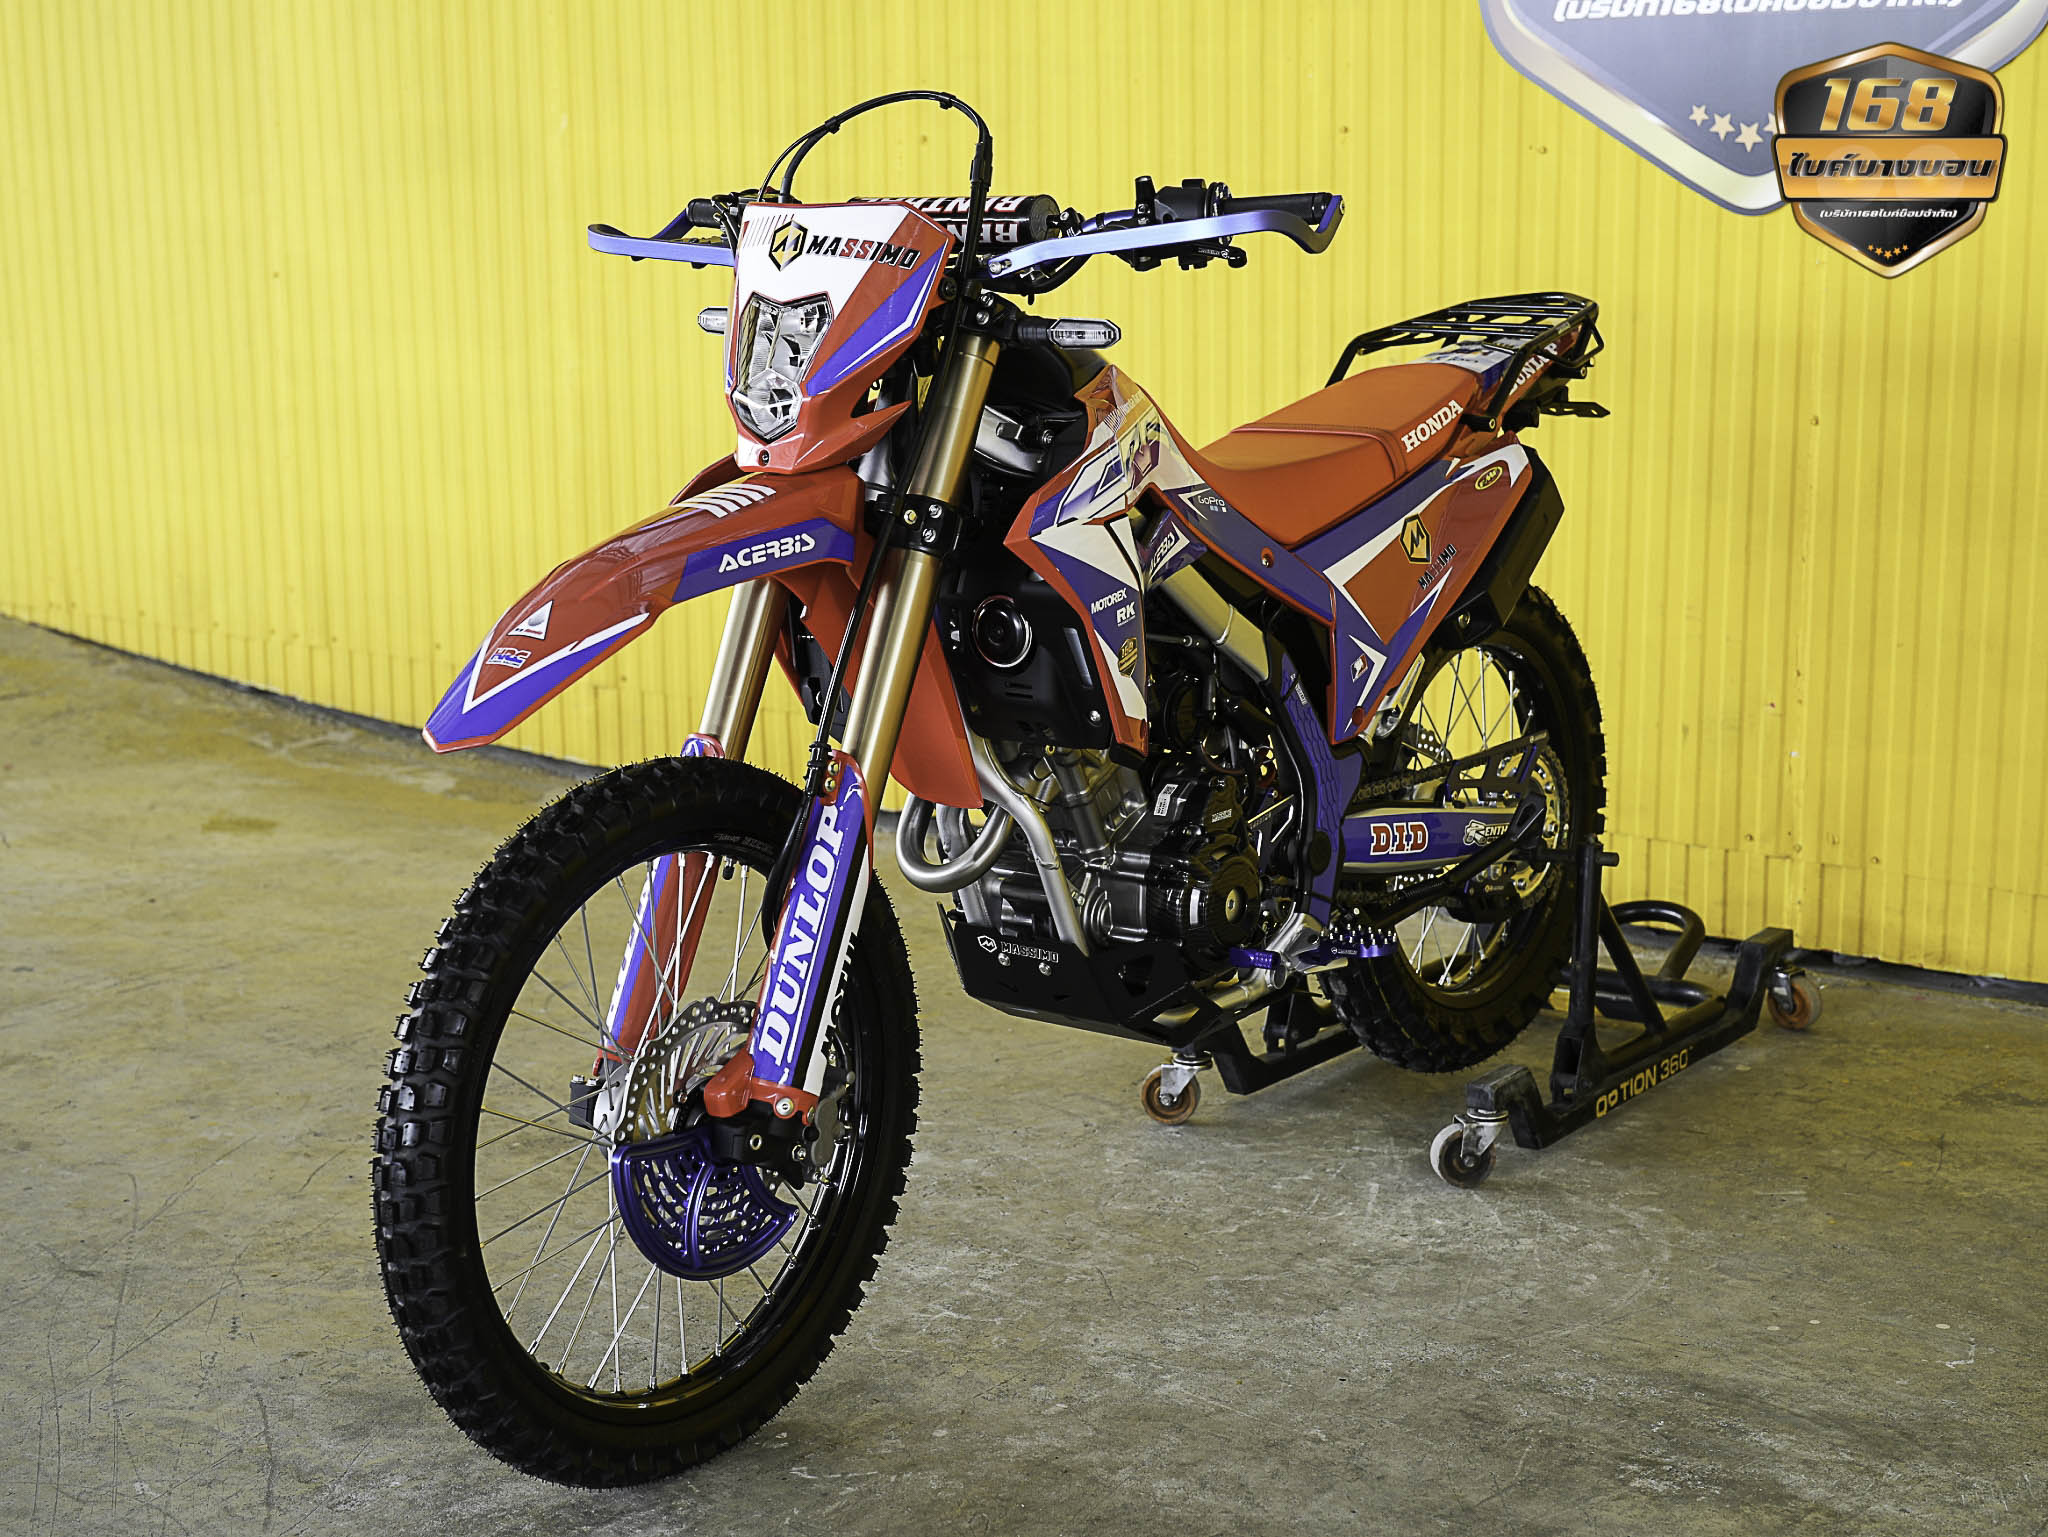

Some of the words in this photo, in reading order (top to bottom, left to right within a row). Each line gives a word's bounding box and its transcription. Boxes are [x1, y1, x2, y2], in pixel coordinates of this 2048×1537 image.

[806, 235, 920, 270] MASSIMO
[1401, 400, 1463, 453] HONDA
[1197, 495, 1226, 507] GoPro
[1417, 543, 1458, 591] MASSIMO
[1090, 587, 1128, 615] MOTOREX
[1116, 601, 1136, 624] RK
[759, 805, 844, 1066] DUNLOP
[1001, 941, 1059, 963] MASSIMO
[1596, 1064, 1657, 1118] OPTION
